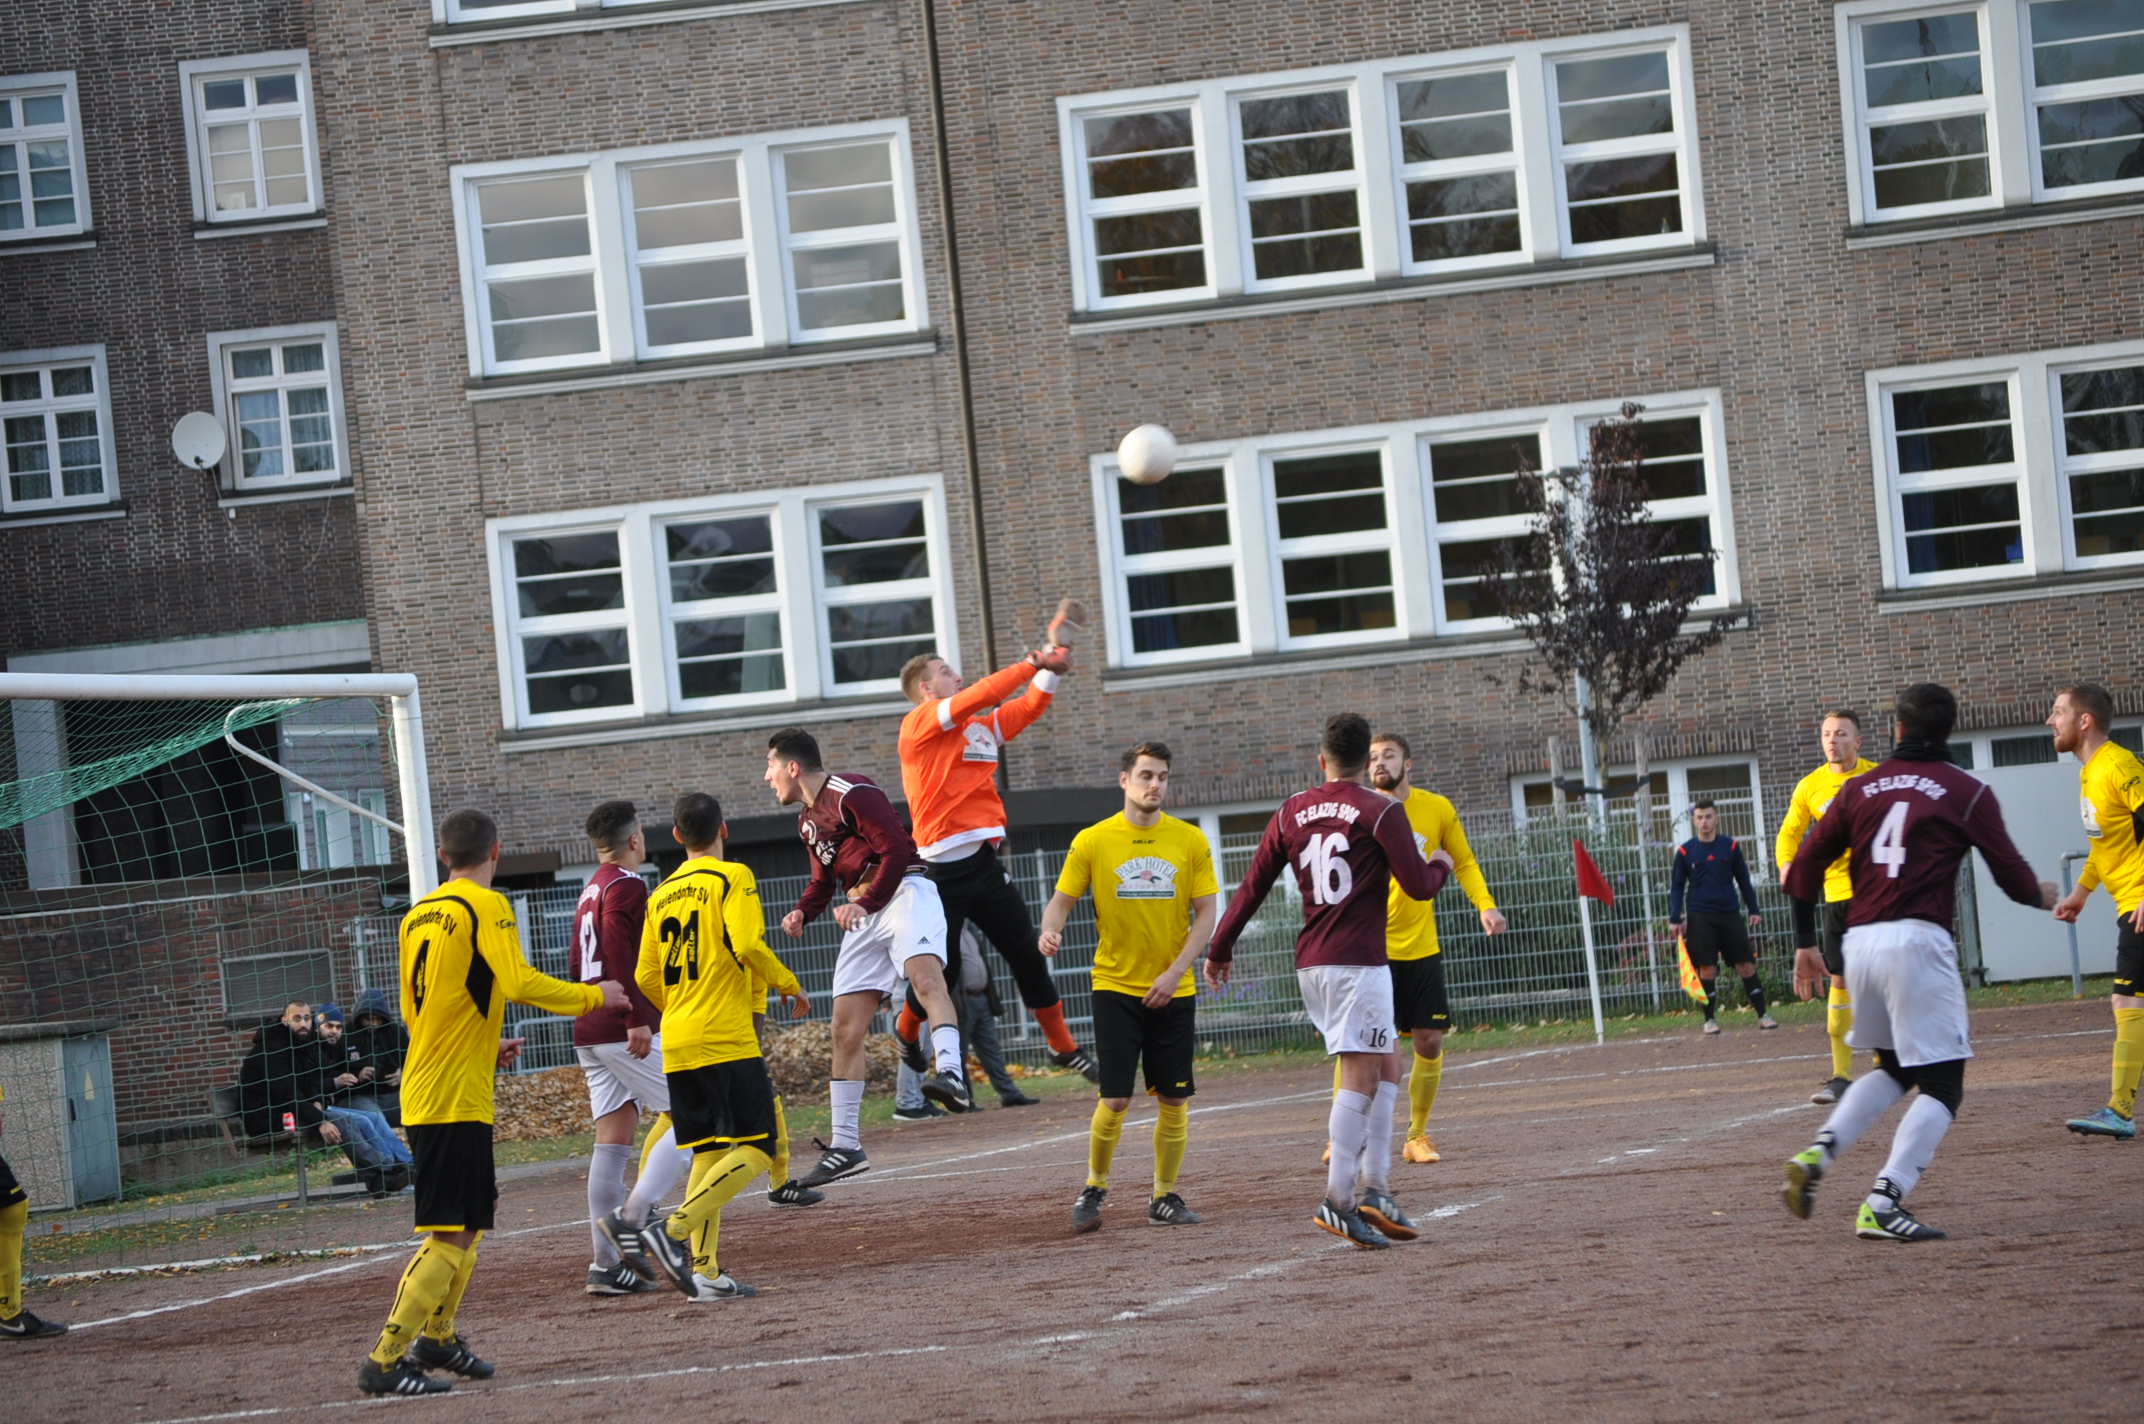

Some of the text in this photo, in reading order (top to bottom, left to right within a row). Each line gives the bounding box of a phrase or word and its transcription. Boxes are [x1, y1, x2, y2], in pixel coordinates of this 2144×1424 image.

[1295, 810, 1308, 828] FC
[1337, 803, 1361, 825] SPOR
[1871, 801, 1911, 878] 4
[1115, 857, 1177, 879] PARK HOTEL
[1299, 832, 1353, 905] 16
[697, 886, 710, 905] SV
[443, 913, 457, 936] SV
[580, 911, 603, 982] 12
[660, 910, 699, 986] 21
[1368, 1027, 1388, 1048] 16
